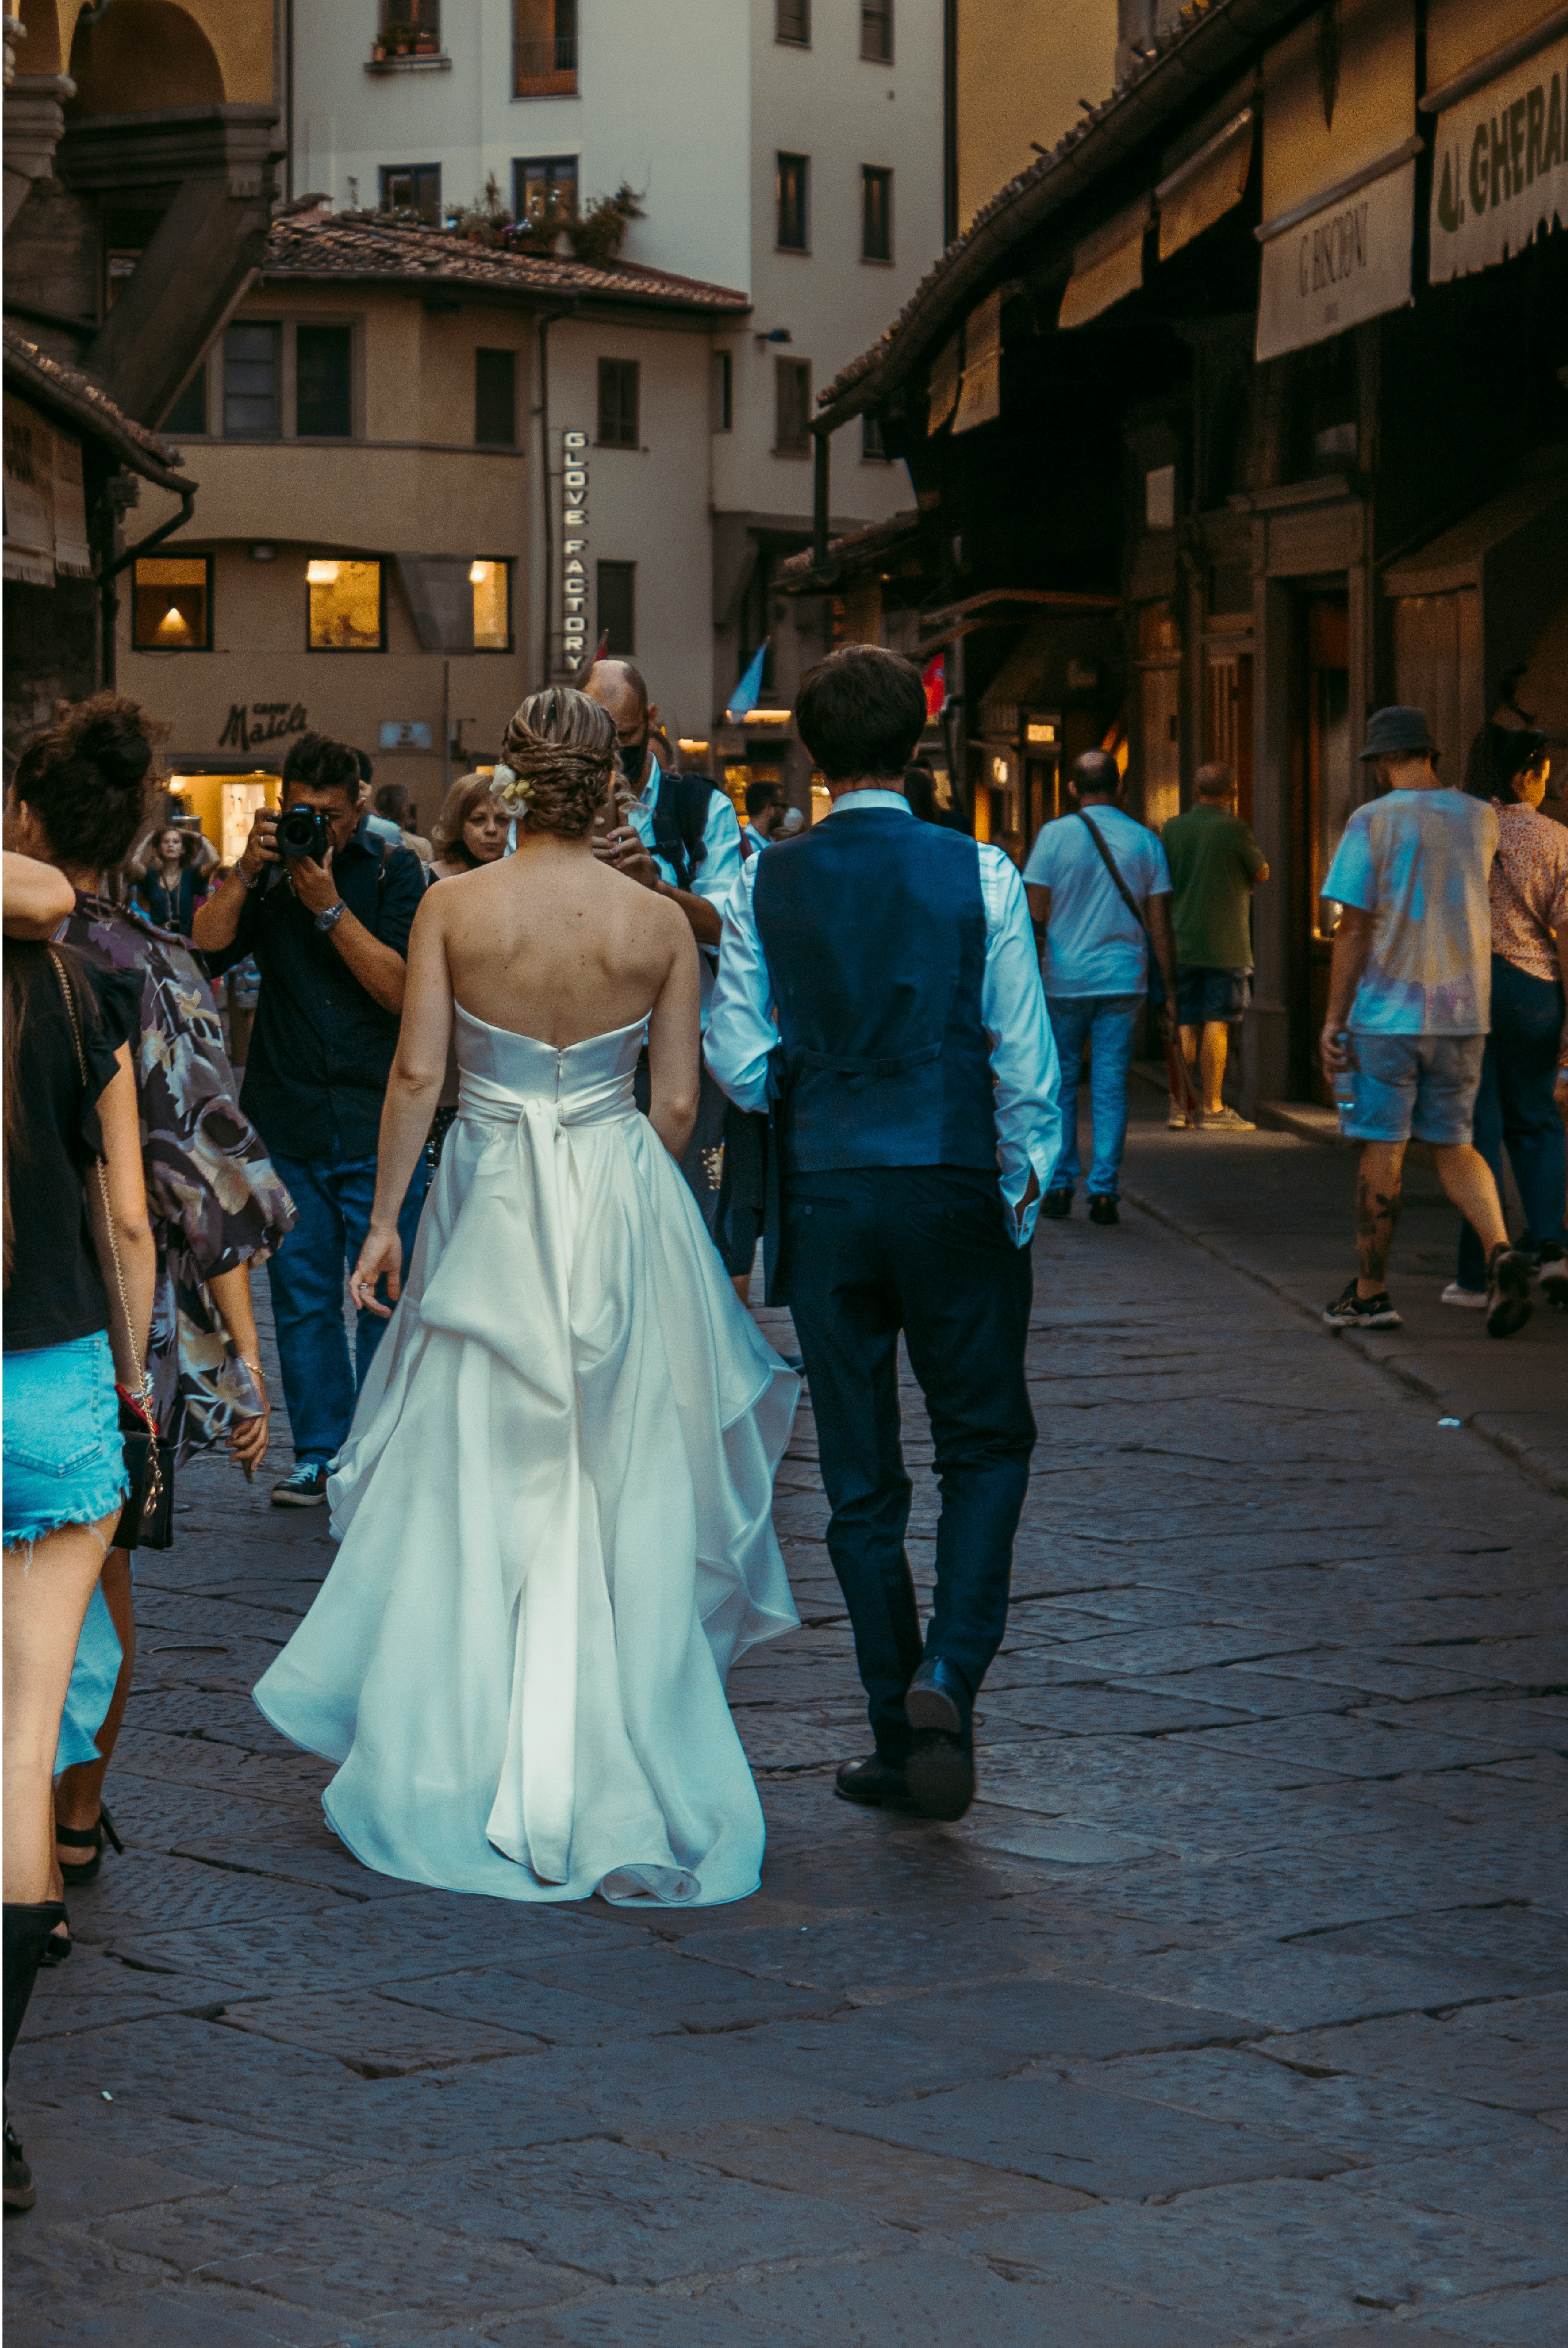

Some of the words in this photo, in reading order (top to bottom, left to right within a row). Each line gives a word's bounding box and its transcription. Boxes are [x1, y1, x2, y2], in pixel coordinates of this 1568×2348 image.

[1470, 67, 1568, 215] GHERA
[564, 431, 585, 525] GLOVE
[564, 539, 585, 670] FACTORY
